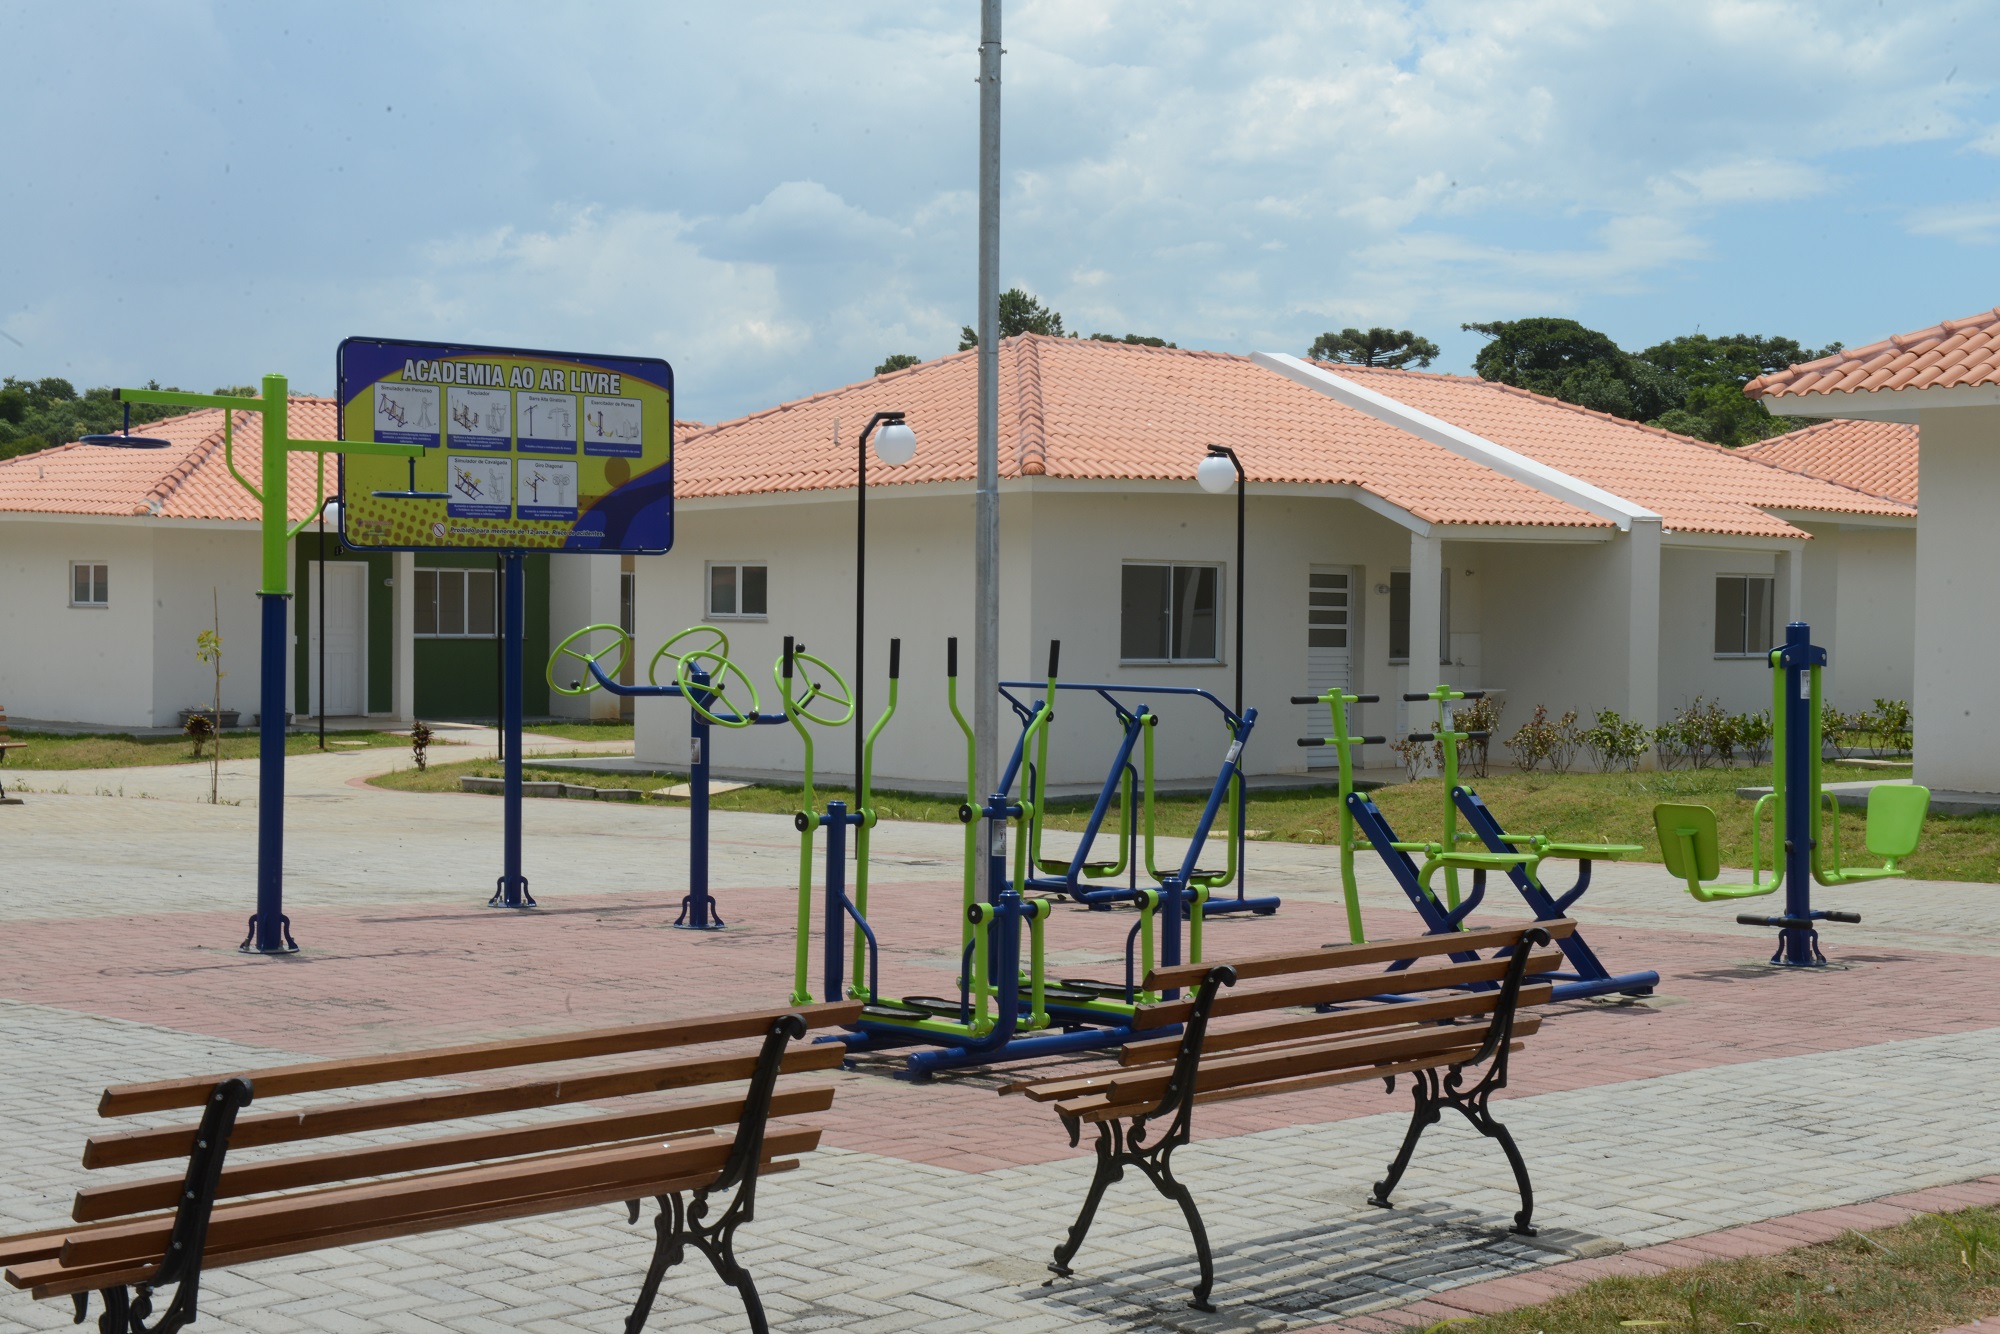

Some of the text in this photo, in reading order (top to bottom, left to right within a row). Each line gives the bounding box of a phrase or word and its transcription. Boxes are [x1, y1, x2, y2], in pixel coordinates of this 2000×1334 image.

[402, 359, 621, 395] ACADEMIA AO AR LIVRE
